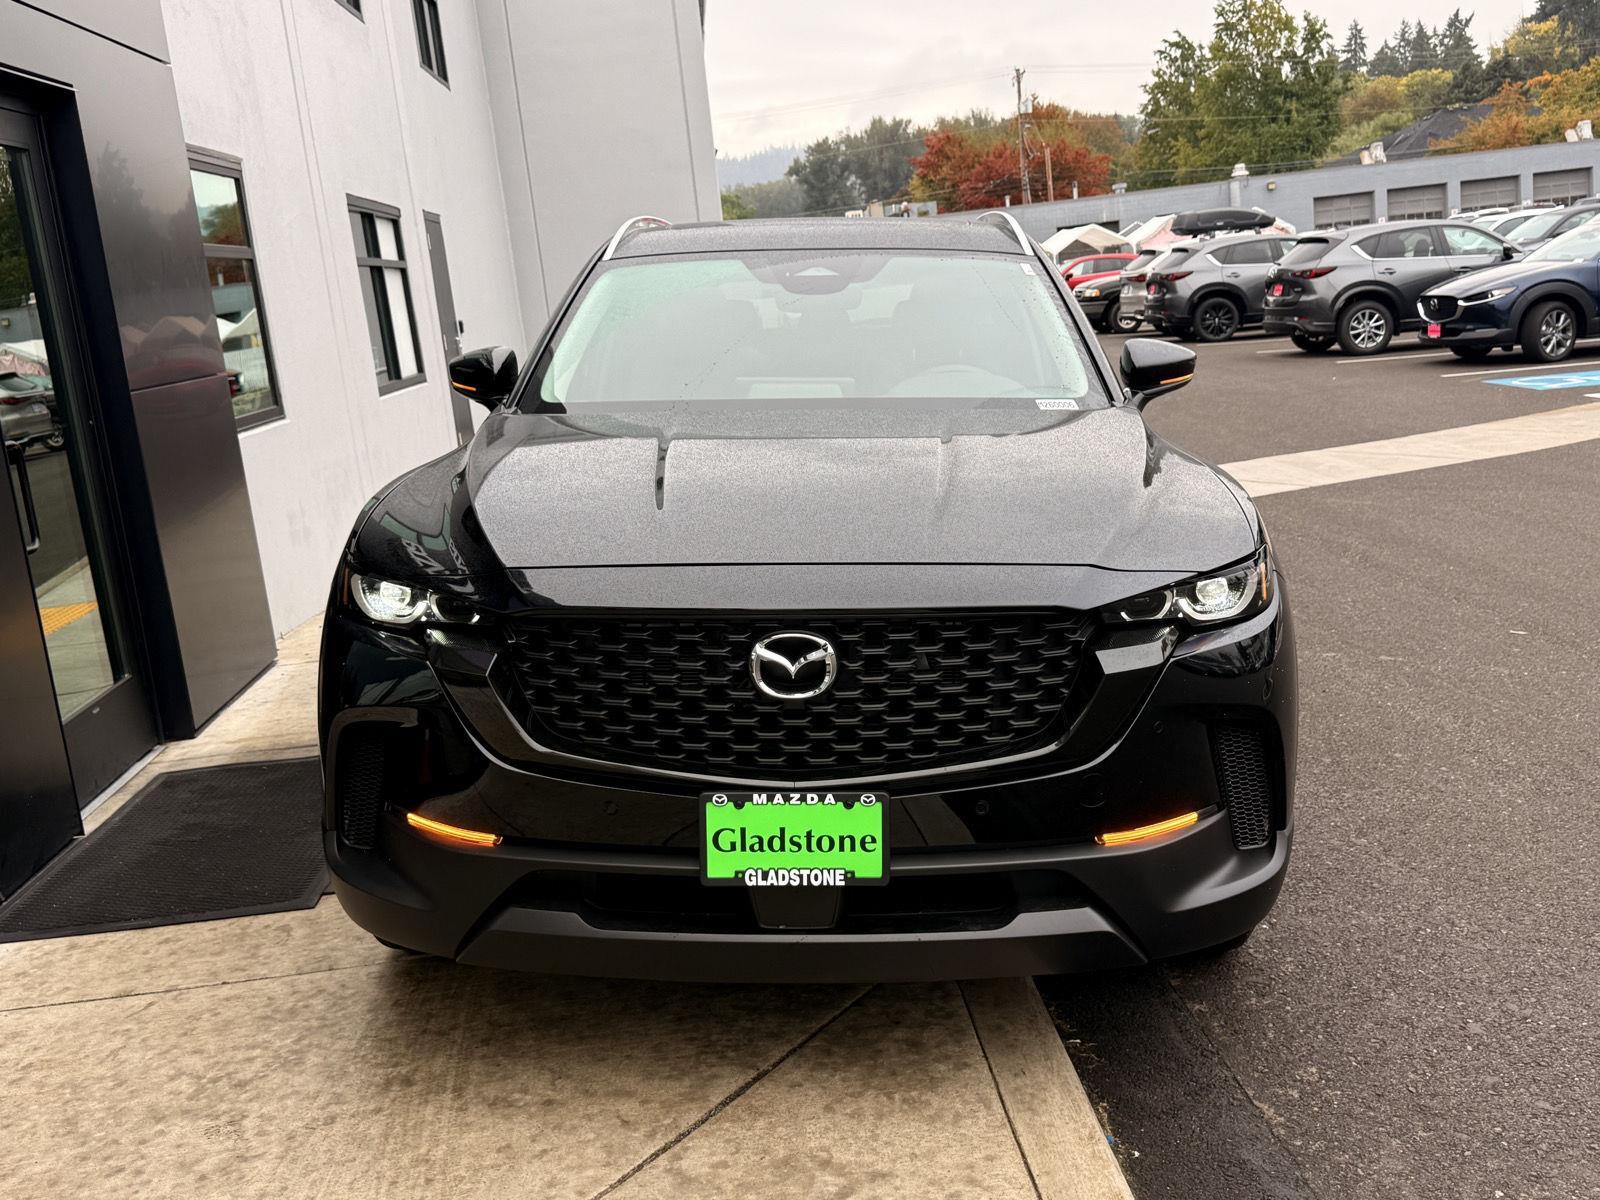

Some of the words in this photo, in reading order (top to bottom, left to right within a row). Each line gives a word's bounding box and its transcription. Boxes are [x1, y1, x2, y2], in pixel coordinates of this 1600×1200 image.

[753, 793, 836, 805] MAZDA
[712, 827, 877, 852] Gladstone
[744, 868, 846, 886] GLADSTONE
